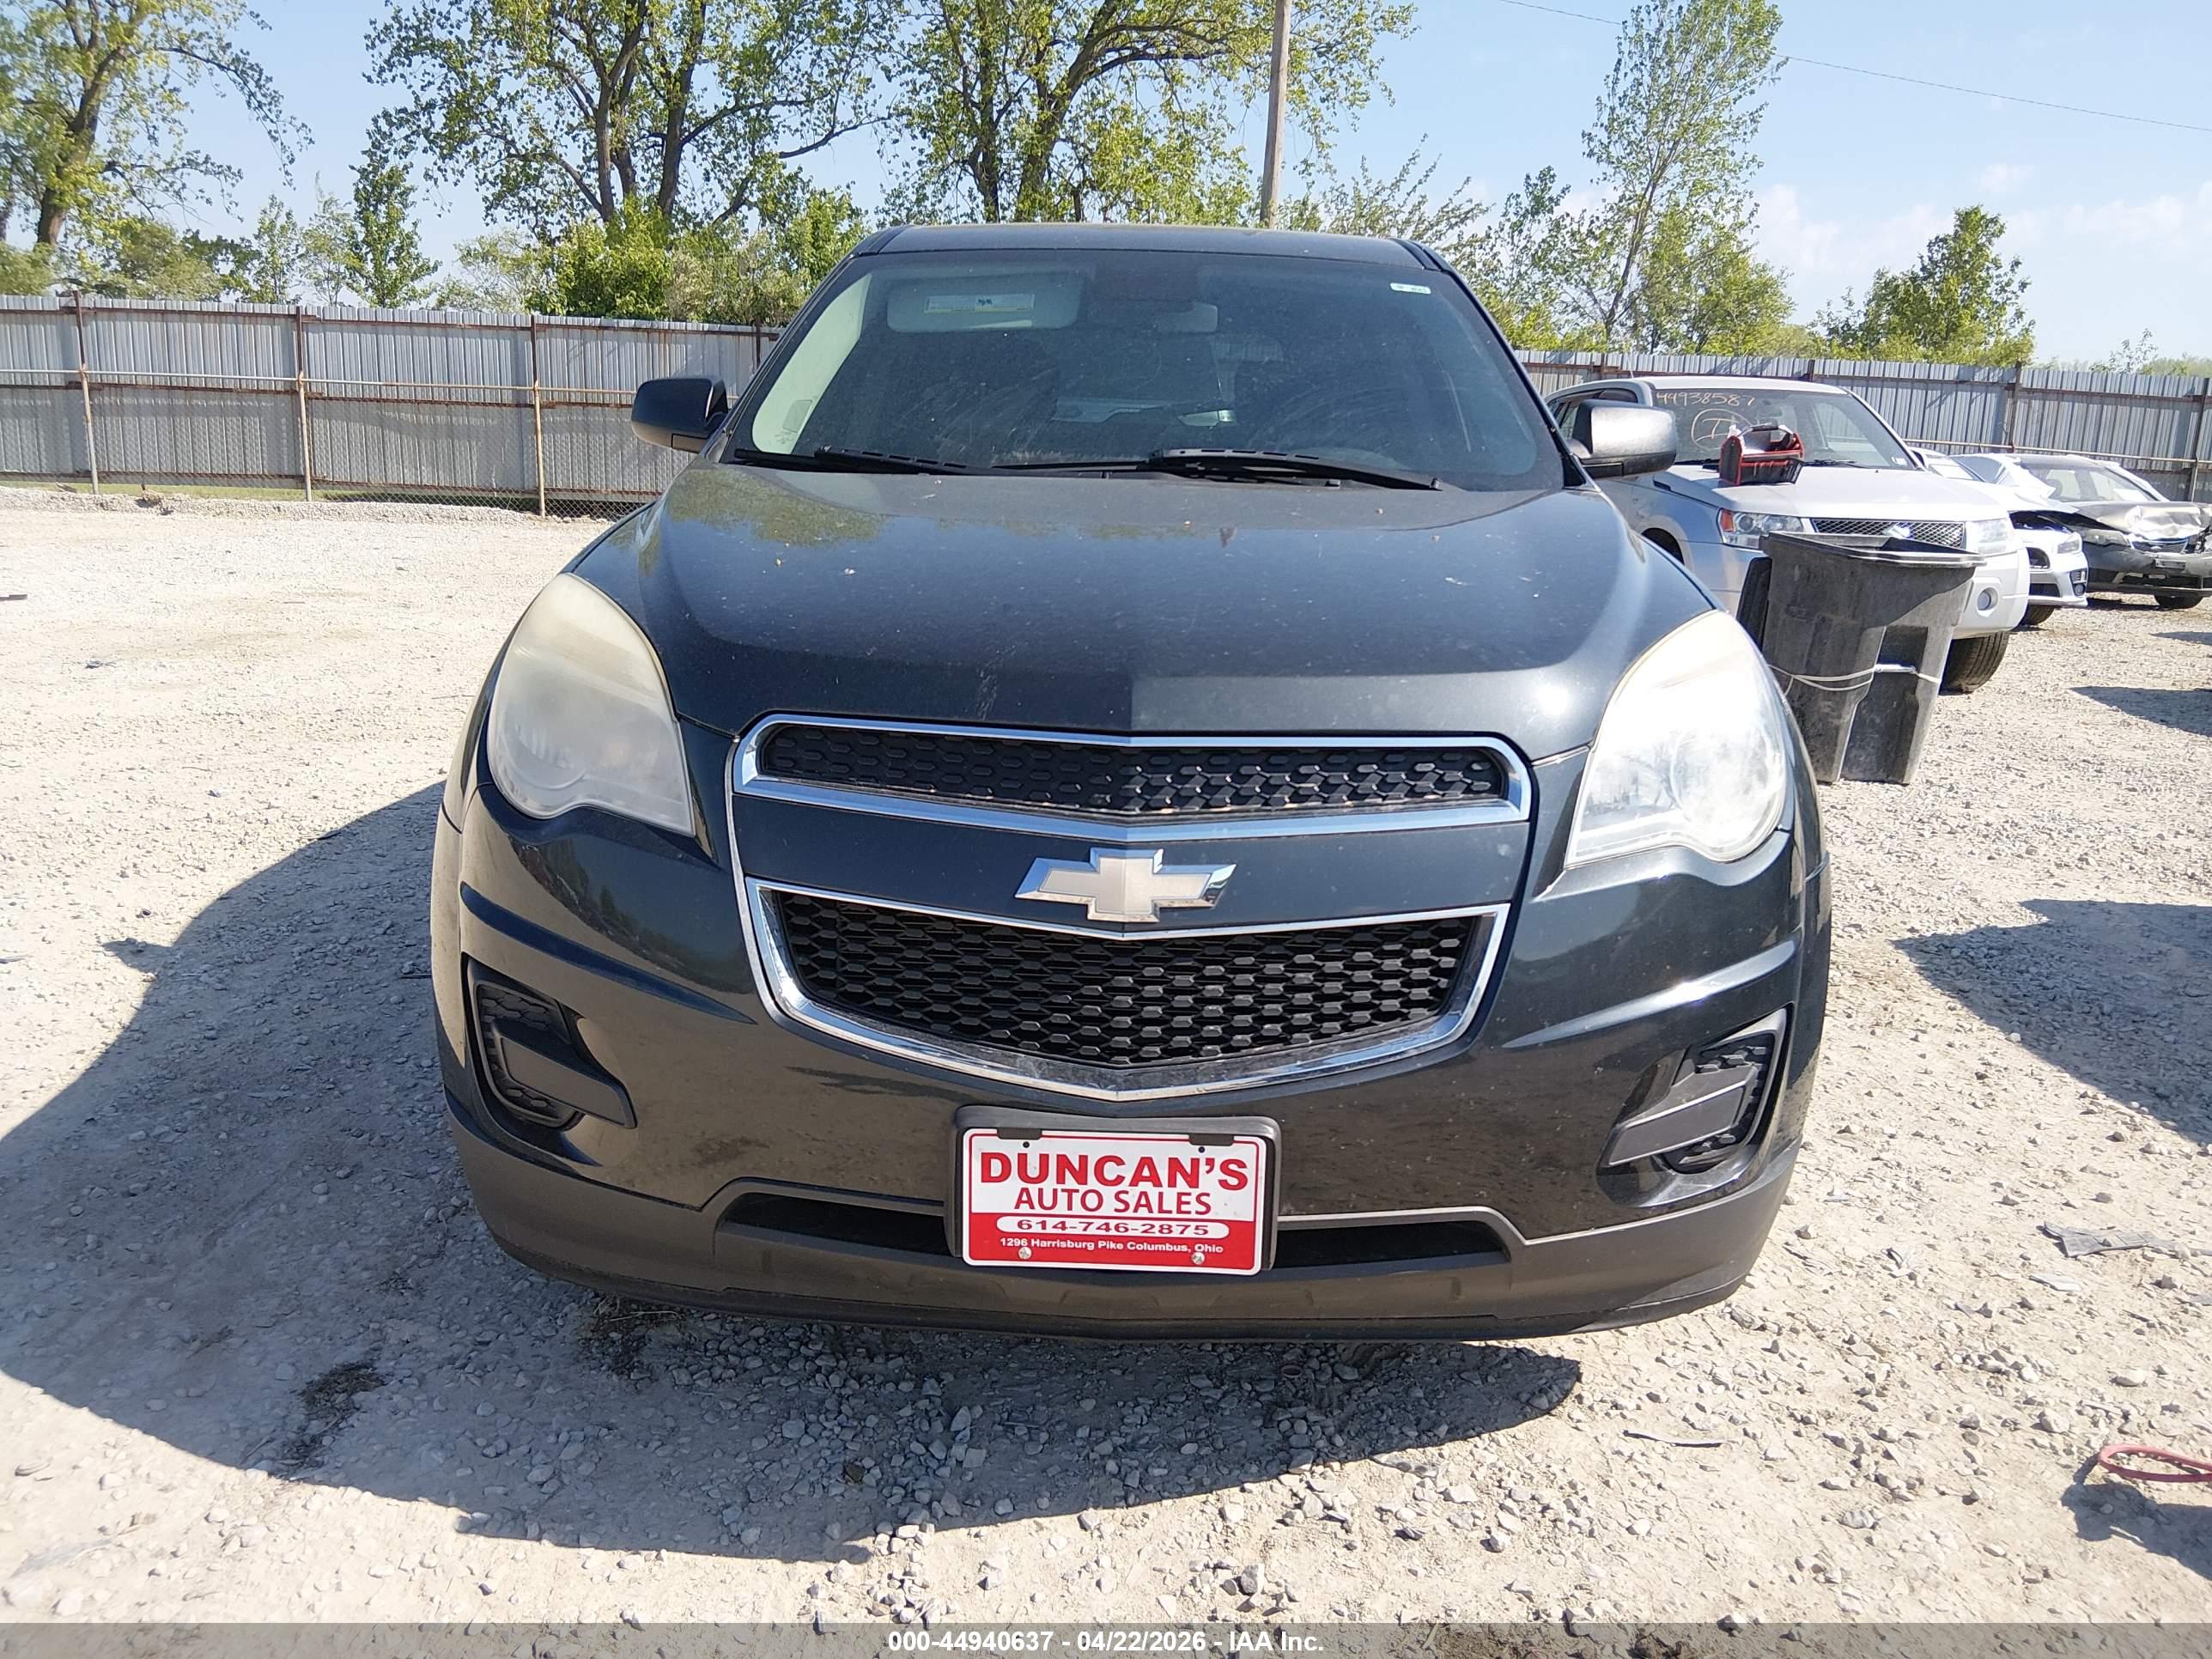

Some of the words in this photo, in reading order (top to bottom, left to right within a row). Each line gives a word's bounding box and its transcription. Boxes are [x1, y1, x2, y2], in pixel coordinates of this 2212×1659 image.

[1656, 391, 1755, 406] 44938587
[980, 1152, 1249, 1192] DUNCAN'S
[1014, 1188, 1103, 1212] AUTO
[1114, 1189, 1211, 1215] SALES
[1017, 1219, 1209, 1236] 614-746-2875
[1000, 1237, 1029, 1248] 1296
[1030, 1238, 1095, 1251] Harrisburg
[1098, 1240, 1124, 1250] Pike
[1127, 1242, 1191, 1254] Columbus,
[1194, 1243, 1224, 1254] Ohio
